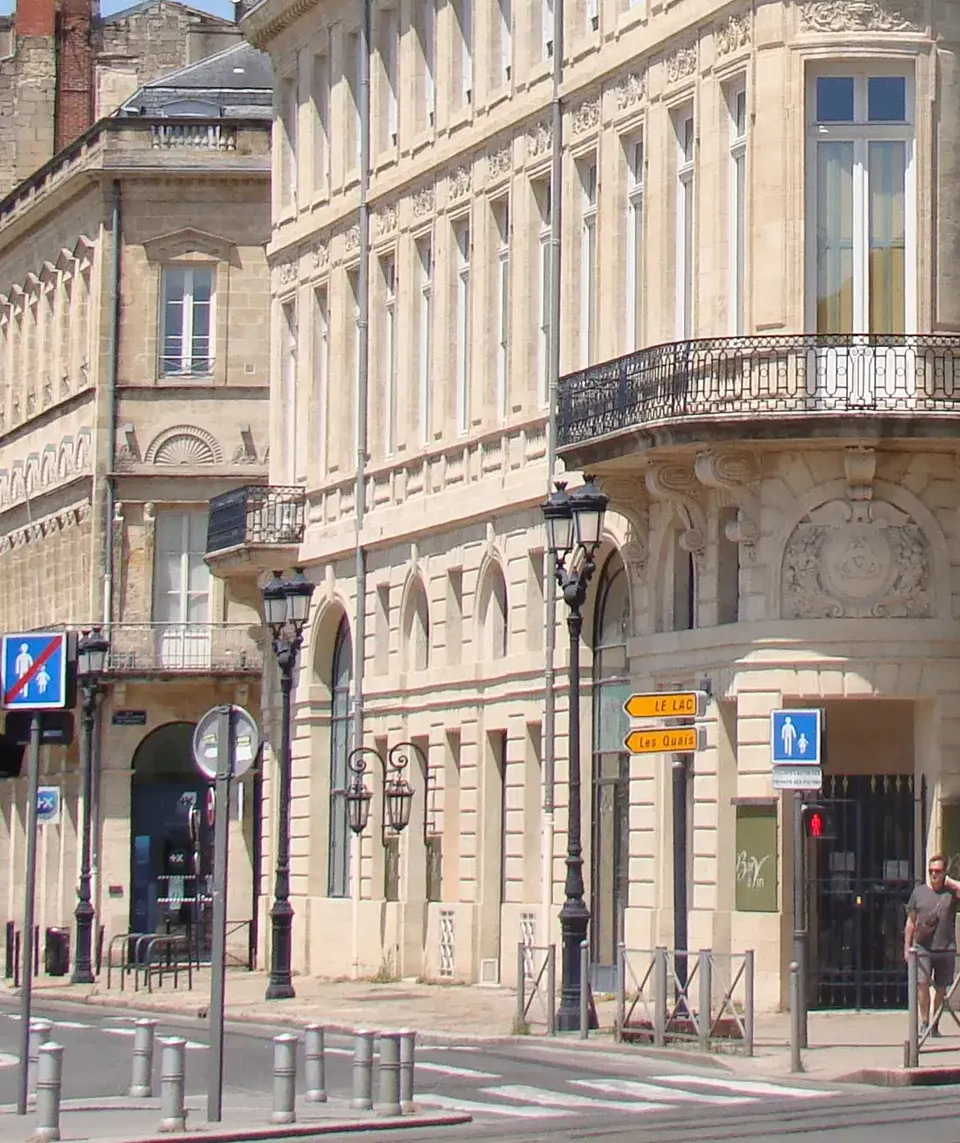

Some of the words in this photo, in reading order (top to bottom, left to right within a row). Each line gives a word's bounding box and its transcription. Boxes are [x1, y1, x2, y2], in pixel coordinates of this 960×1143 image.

[655, 700, 666, 712] LE
[672, 698, 693, 710] LAC
[640, 737, 657, 747] Les
[663, 735, 694, 747] Quais
